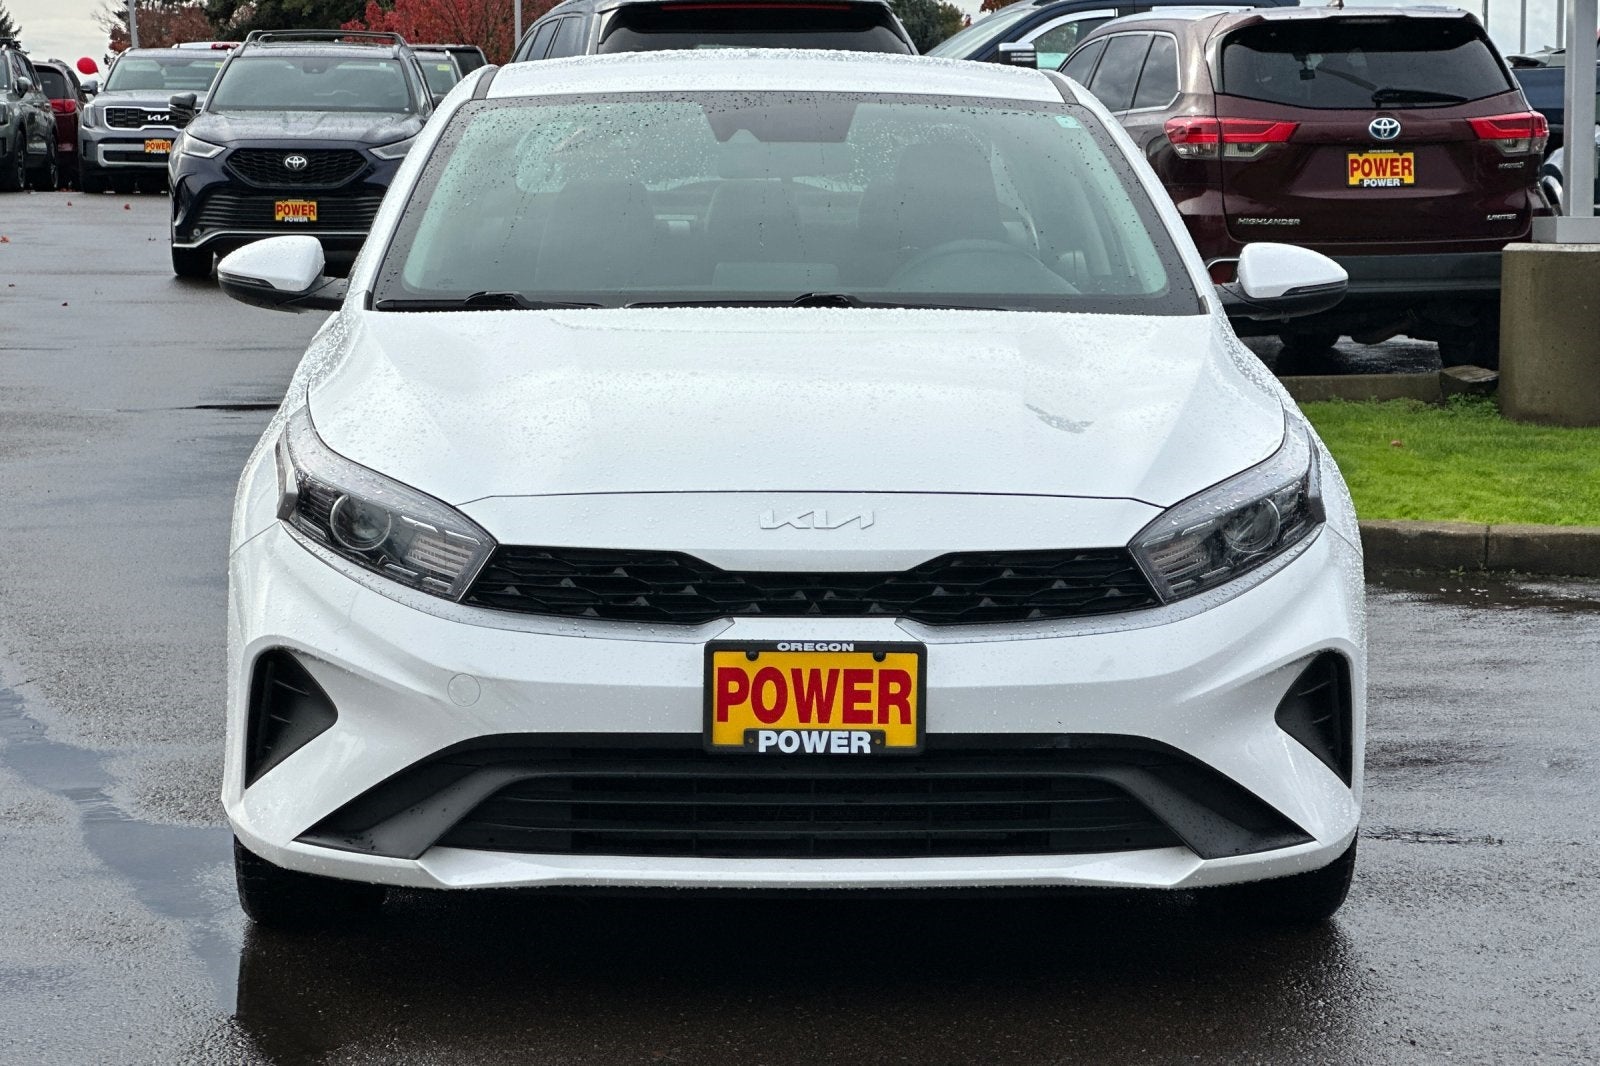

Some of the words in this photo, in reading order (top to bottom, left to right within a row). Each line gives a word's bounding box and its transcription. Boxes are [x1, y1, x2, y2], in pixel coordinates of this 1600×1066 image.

[146, 142, 171, 150] POWER
[1349, 157, 1413, 178] POWER
[1363, 178, 1401, 187] POWER
[276, 204, 316, 216] POWER
[1237, 217, 1301, 226] HIGHLANDER
[758, 509, 875, 530] KIA
[776, 642, 855, 652] OREGON
[716, 666, 912, 725] POWER
[758, 730, 871, 754] POWER
